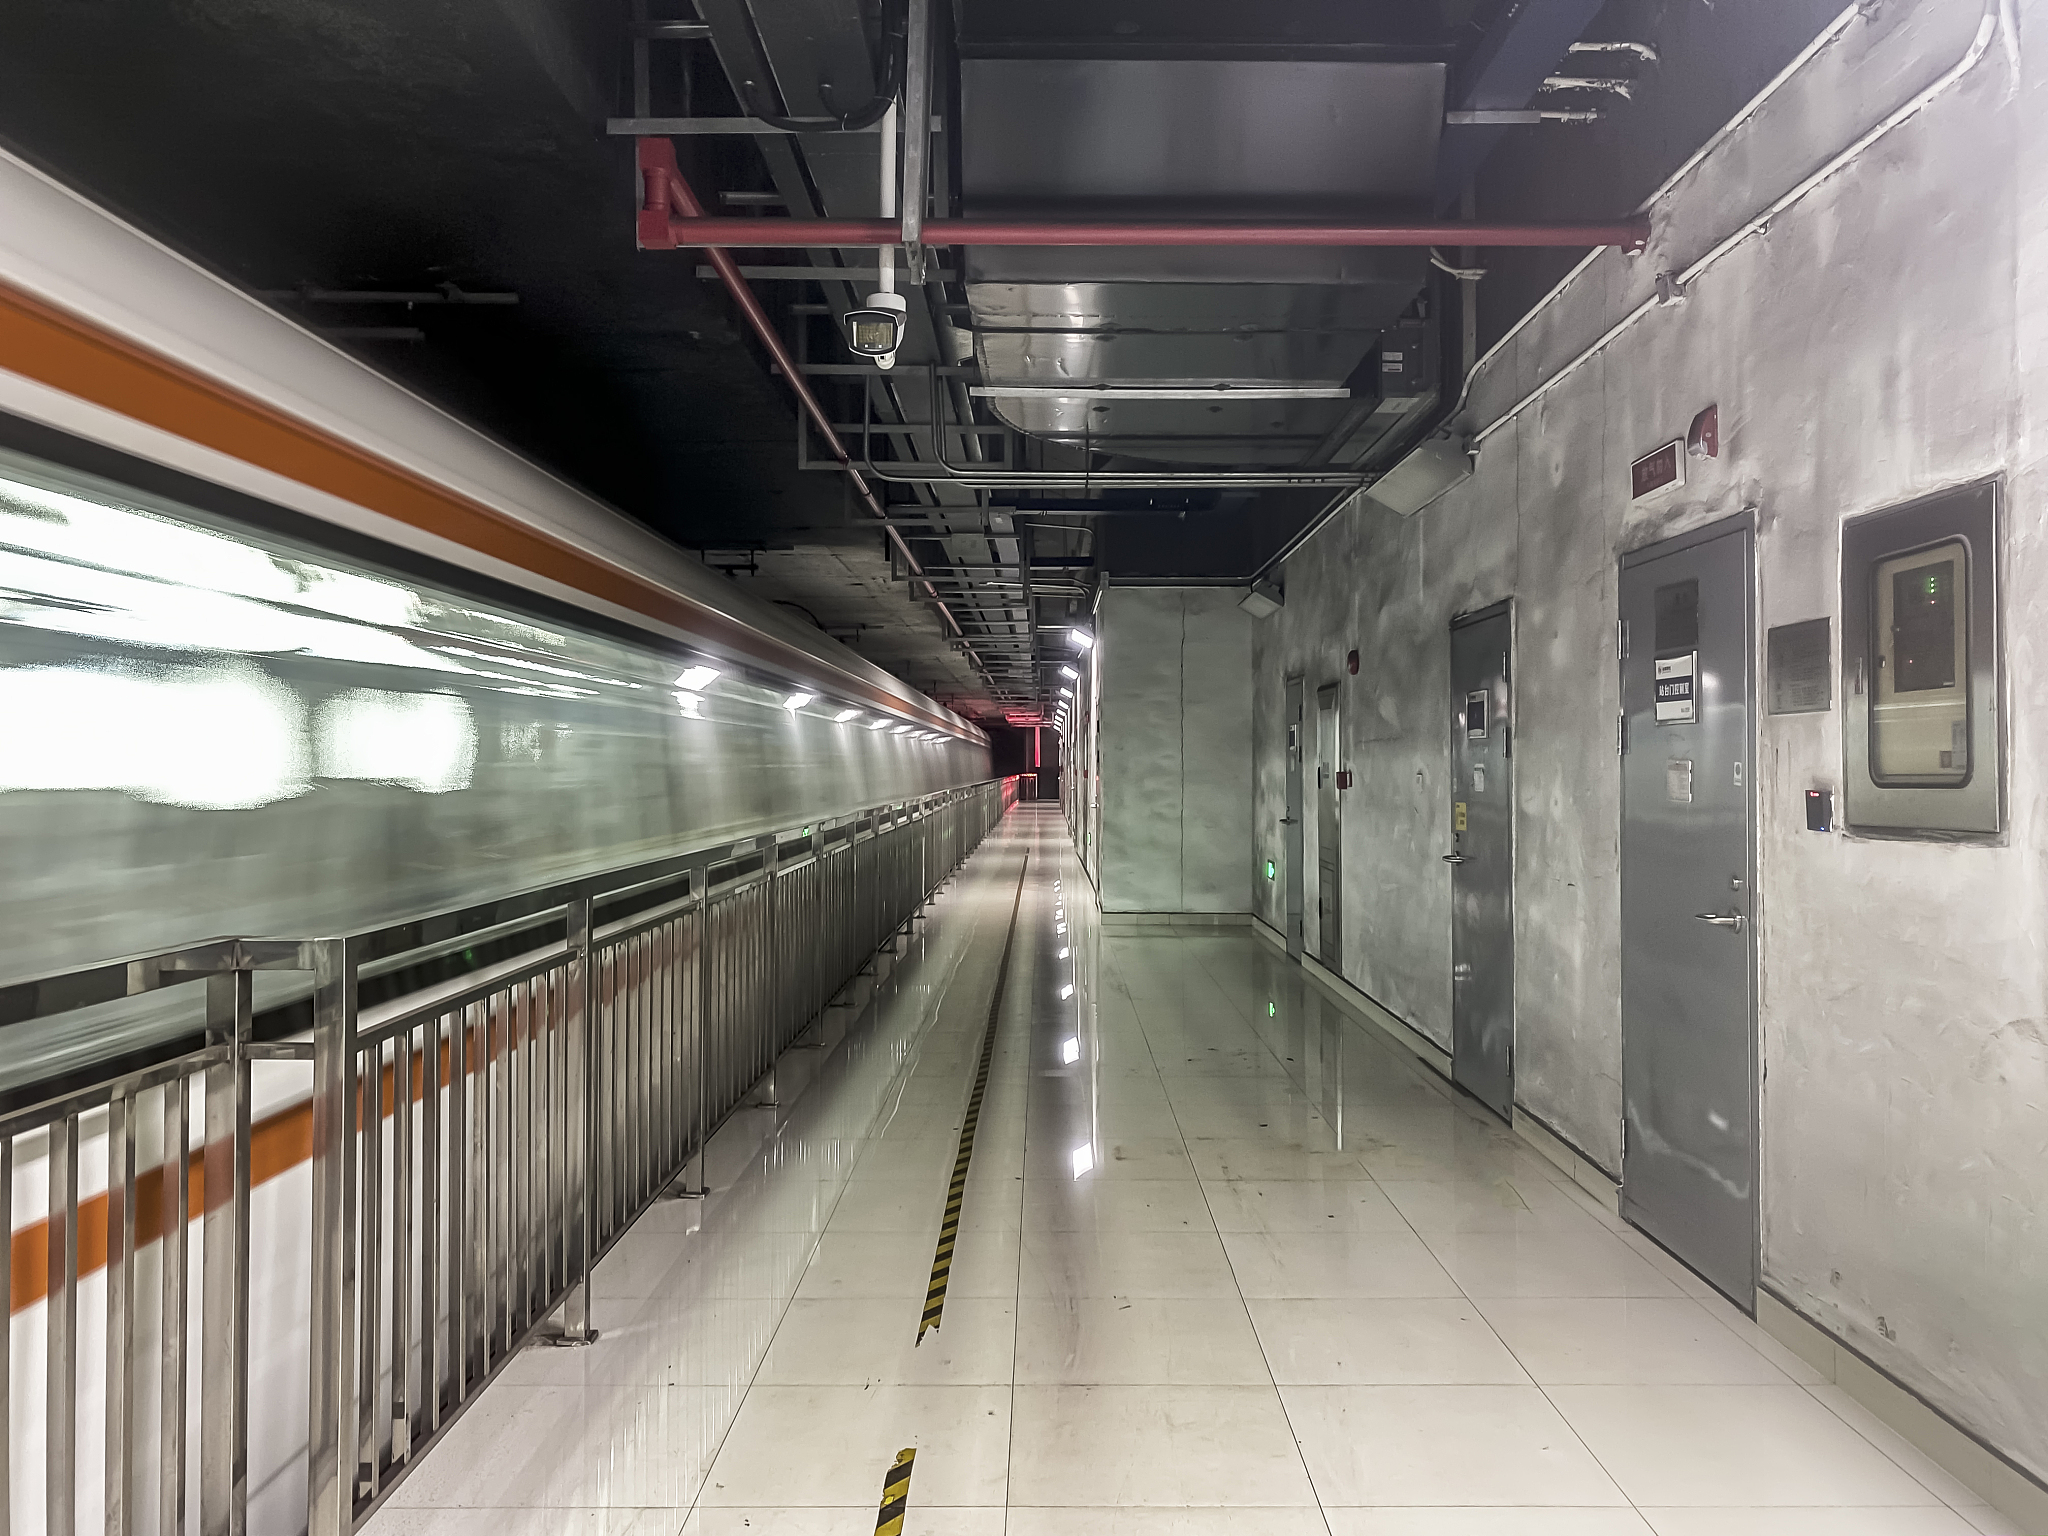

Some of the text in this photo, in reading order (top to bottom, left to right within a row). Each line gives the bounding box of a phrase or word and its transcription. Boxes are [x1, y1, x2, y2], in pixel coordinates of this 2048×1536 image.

[1658, 682, 1690, 697] 站台门控制室
